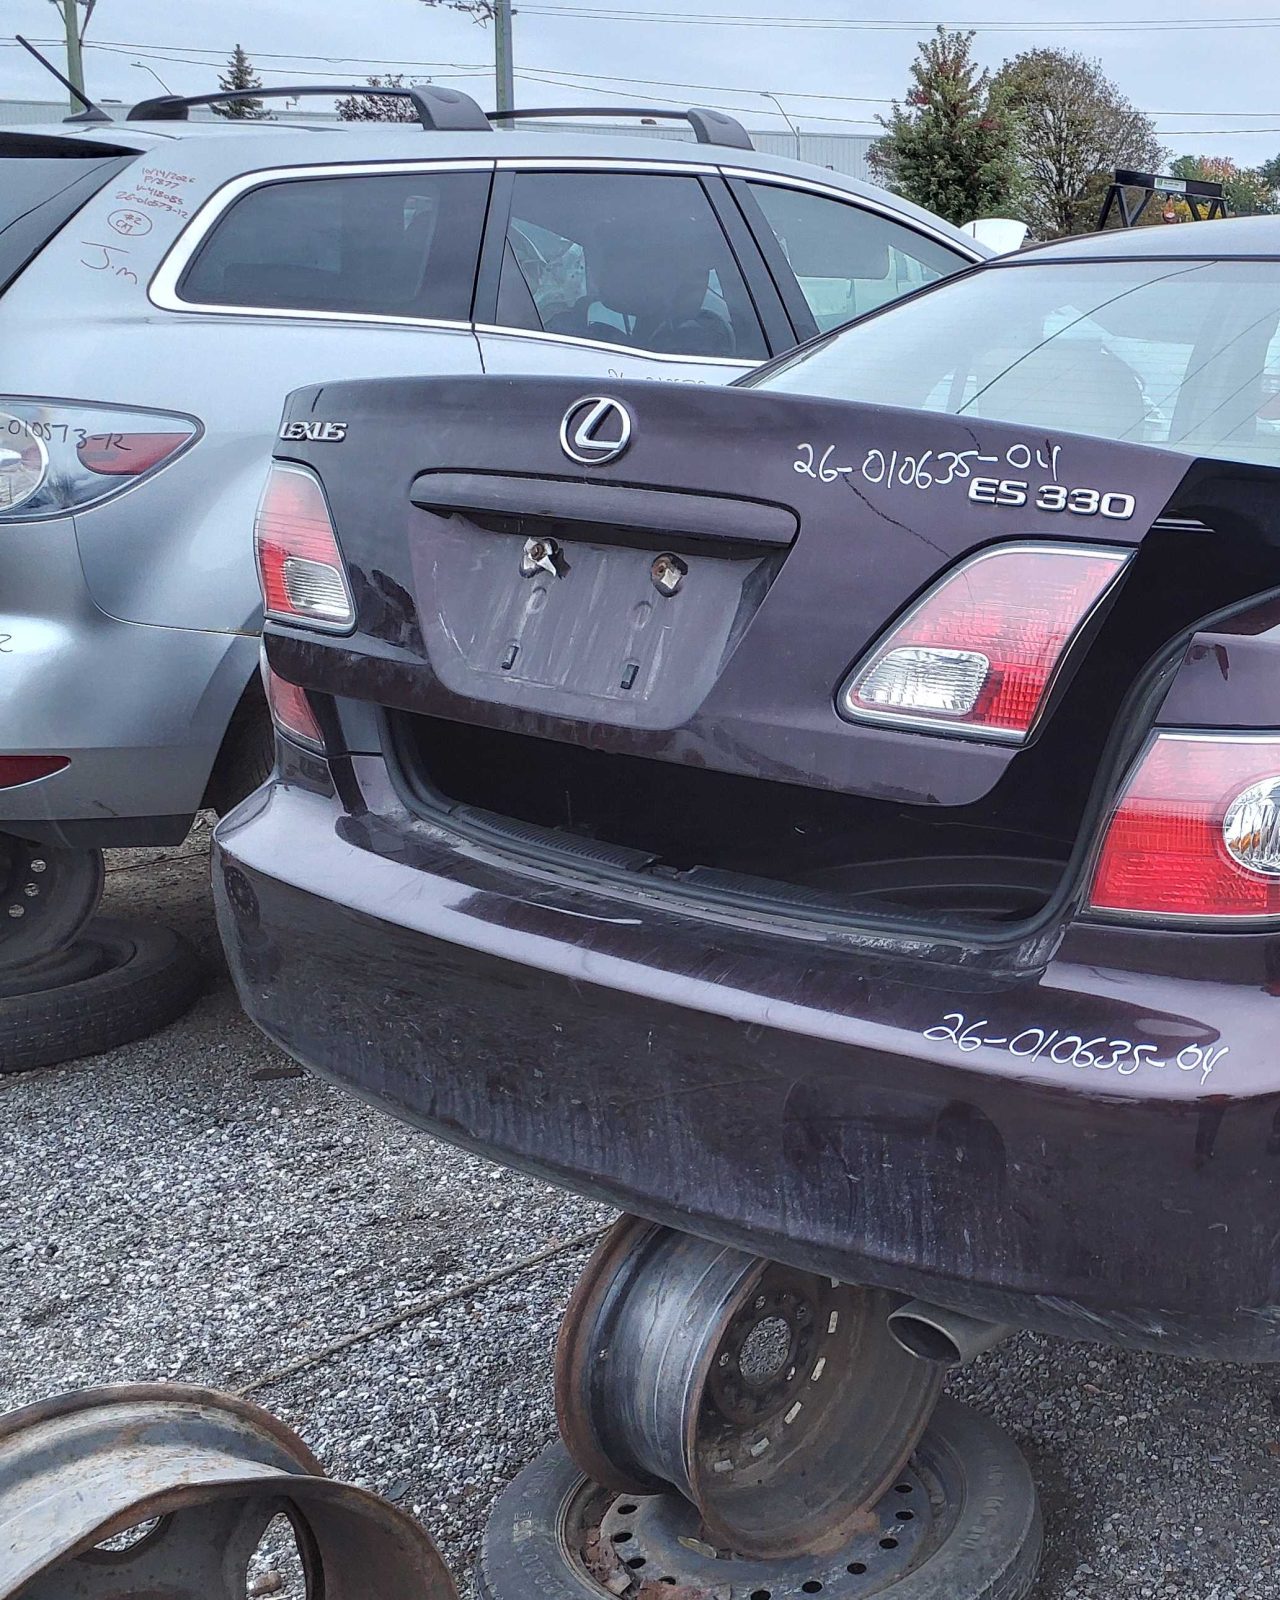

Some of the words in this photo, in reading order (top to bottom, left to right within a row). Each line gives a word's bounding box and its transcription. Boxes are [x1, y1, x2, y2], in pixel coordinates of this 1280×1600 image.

[280, 420, 349, 443] LEXUS
[793, 442, 1062, 490] 26-010635-04
[967, 476, 1029, 508] ES
[1035, 483, 1136, 521] 330
[922, 1012, 1230, 1086] 26-010635-04
